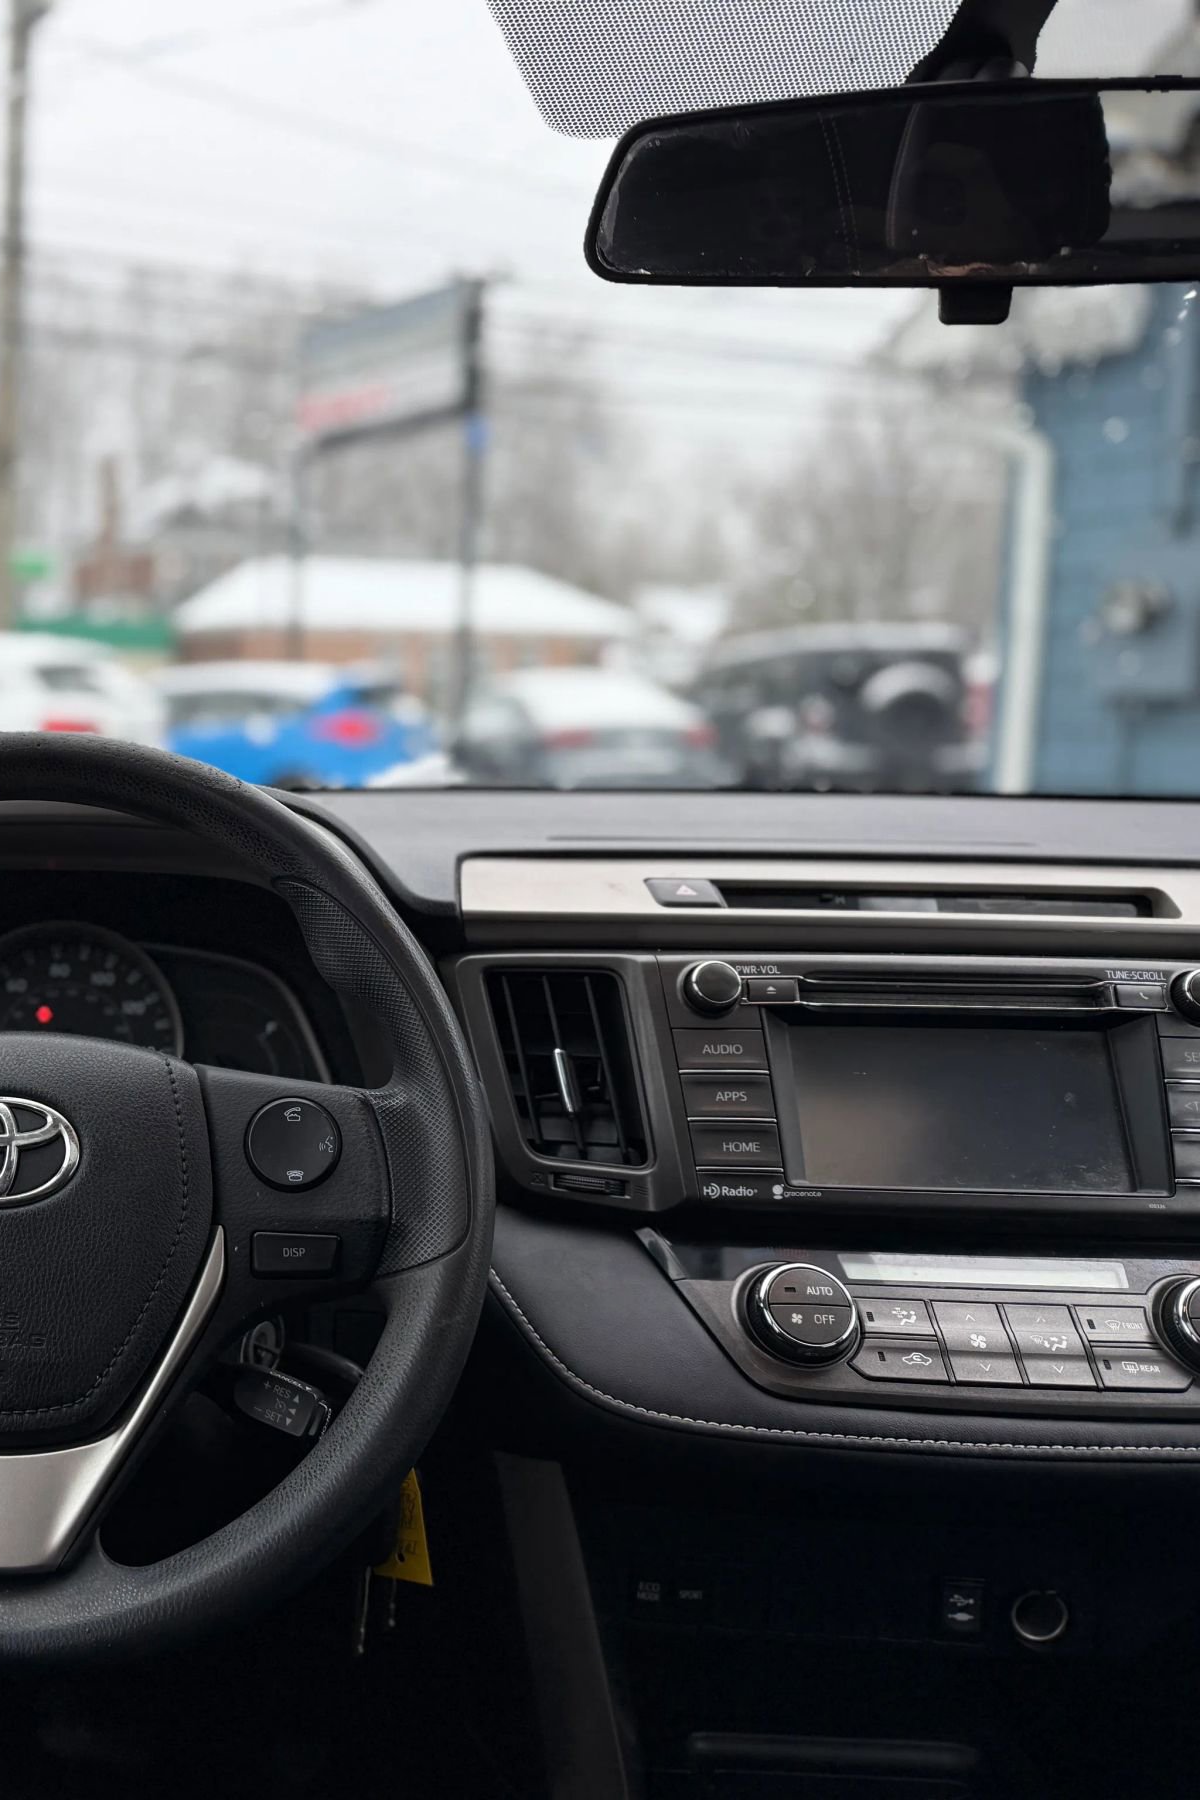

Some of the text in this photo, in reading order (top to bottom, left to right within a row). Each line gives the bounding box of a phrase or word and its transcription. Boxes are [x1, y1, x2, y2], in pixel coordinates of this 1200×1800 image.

[702, 1044, 743, 1055] AUDIO
[715, 1091, 747, 1102] APPS
[723, 1142, 761, 1152] HOME
[282, 1248, 306, 1257] DISP
[806, 1285, 833, 1297] AUTO
[814, 1314, 836, 1325] OFF
[1121, 1322, 1144, 1330] FRONT
[1139, 1364, 1161, 1373] REAR
[273, 1384, 292, 1399] RES
[264, 1409, 284, 1423] SET
